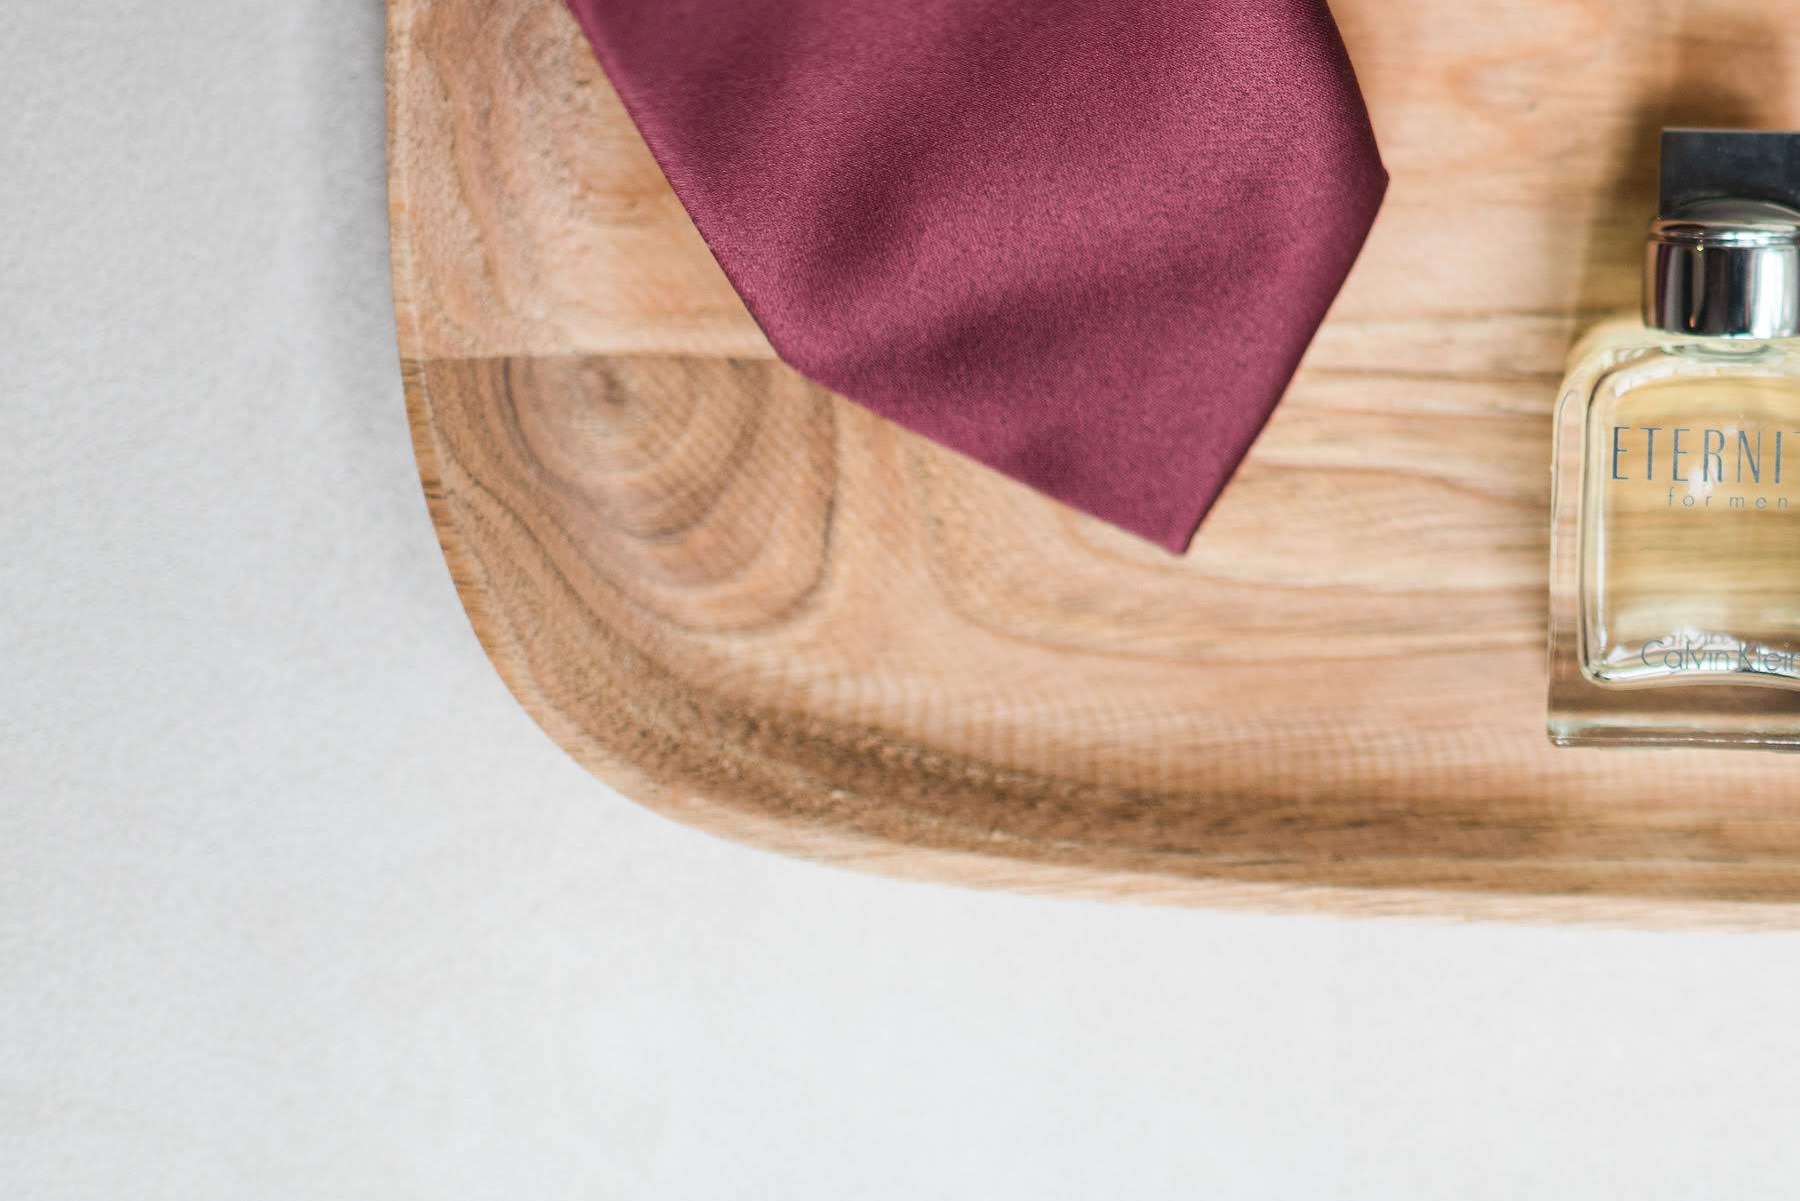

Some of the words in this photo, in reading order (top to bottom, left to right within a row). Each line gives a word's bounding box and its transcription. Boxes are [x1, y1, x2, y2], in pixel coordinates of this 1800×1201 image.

[1666, 486, 1713, 508] for
[1728, 494, 1789, 510] men
[1640, 638, 1731, 674] Calvin
